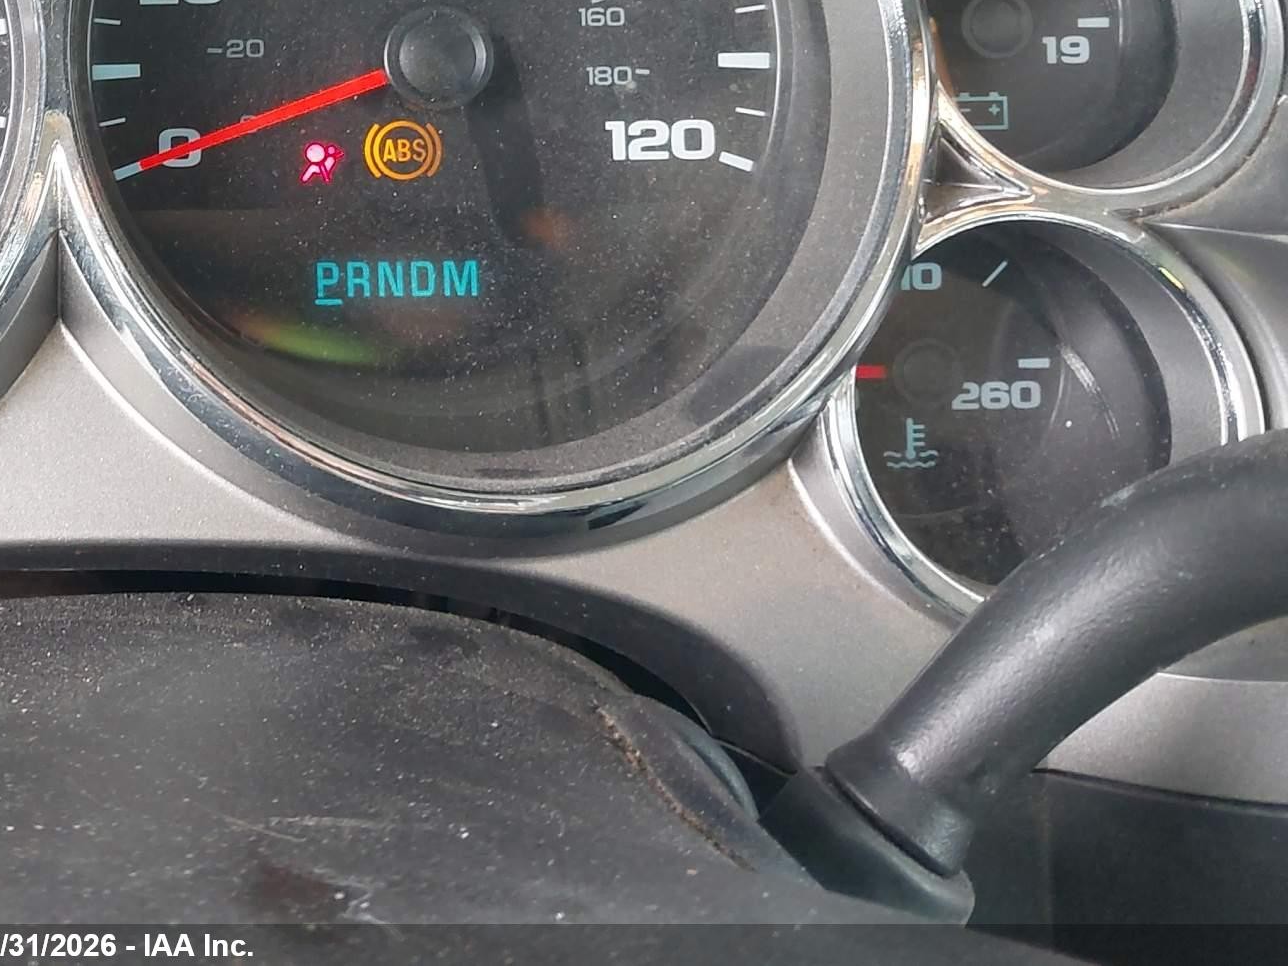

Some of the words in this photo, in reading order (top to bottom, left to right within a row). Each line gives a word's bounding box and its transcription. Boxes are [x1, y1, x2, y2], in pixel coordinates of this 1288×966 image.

[578, 7, 625, 27] 160
[226, 39, 265, 58] 20
[1041, 35, 1090, 64] 19
[586, 66, 632, 86] 180
[158, 127, 202, 168] 0
[383, 138, 426, 163] ABS
[604, 119, 715, 161] 120
[315, 260, 480, 298] PRNDM
[951, 380, 1041, 411] 260
